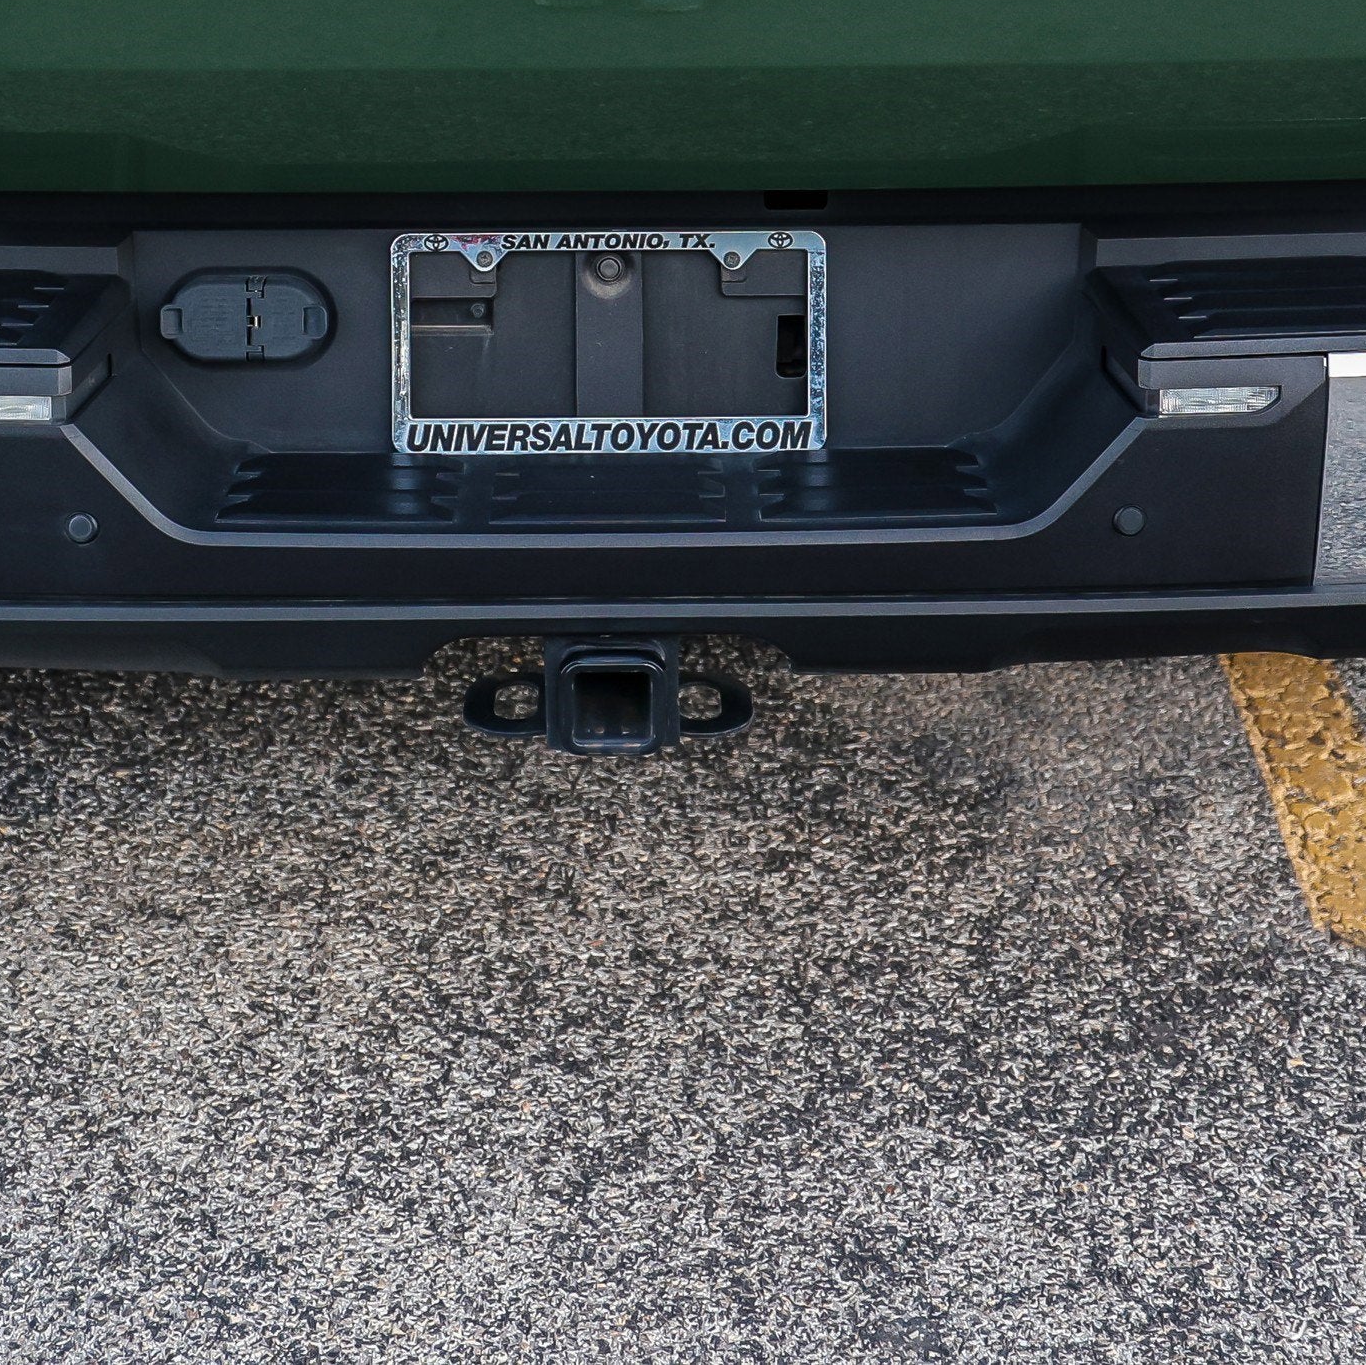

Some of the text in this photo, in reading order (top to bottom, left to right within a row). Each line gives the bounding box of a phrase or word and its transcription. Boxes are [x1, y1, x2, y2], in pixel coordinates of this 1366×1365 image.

[500, 233, 716, 250] SAN ANTONIO, TX.
[406, 420, 814, 453] UNIVERSALTOYOTA.COM
